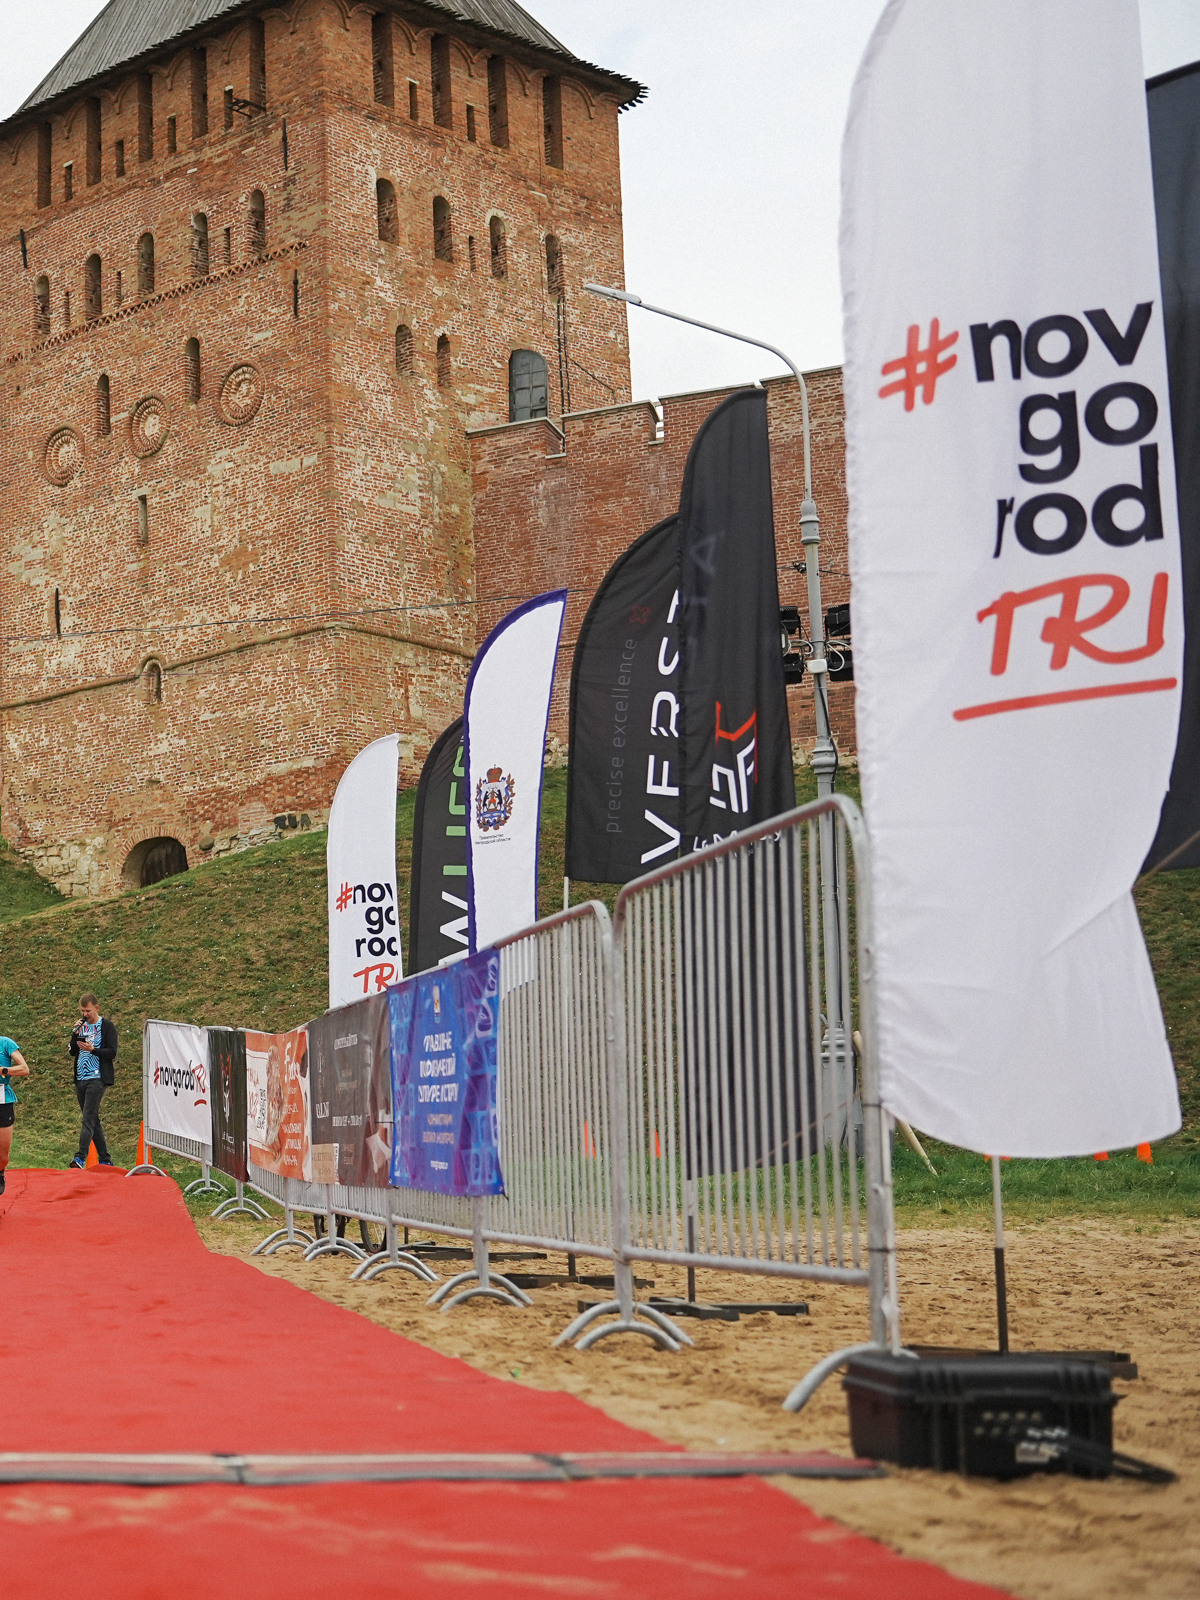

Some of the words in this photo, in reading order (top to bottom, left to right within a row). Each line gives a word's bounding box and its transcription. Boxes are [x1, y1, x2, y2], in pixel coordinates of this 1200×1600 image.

[878, 300, 1155, 412] #nov
[1018, 381, 1159, 484] go
[976, 571, 1170, 677] TRI
[611, 638, 639, 748] excellence
[604, 756, 624, 833] precise
